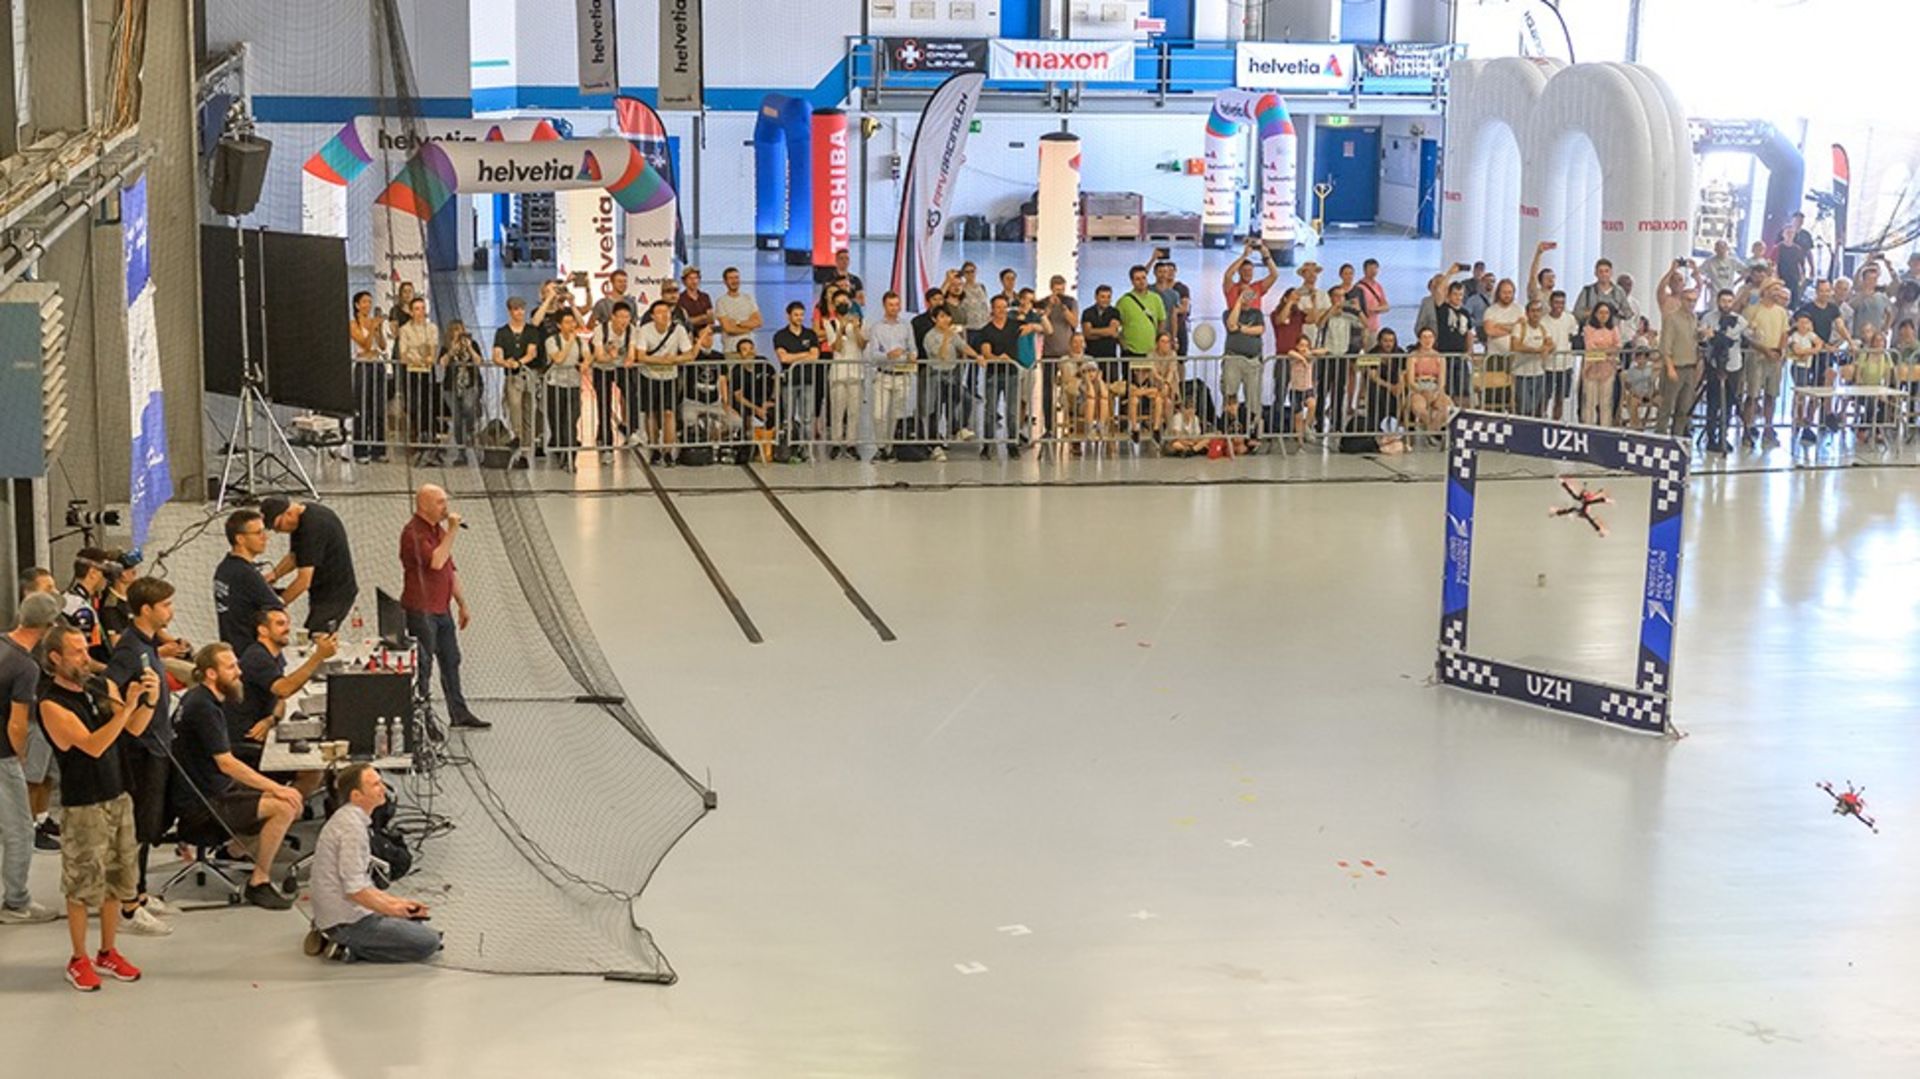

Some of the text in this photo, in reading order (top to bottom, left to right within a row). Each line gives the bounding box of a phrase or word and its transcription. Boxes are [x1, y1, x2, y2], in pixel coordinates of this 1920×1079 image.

[1015, 51, 1109, 70] maxon
[1249, 57, 1320, 75] helvetia
[478, 158, 574, 182] helvetia
[829, 128, 847, 254] TOSHIBA
[1638, 219, 1688, 232] maxon
[1542, 428, 1589, 454] UZH
[1526, 673, 1573, 703] UZH
